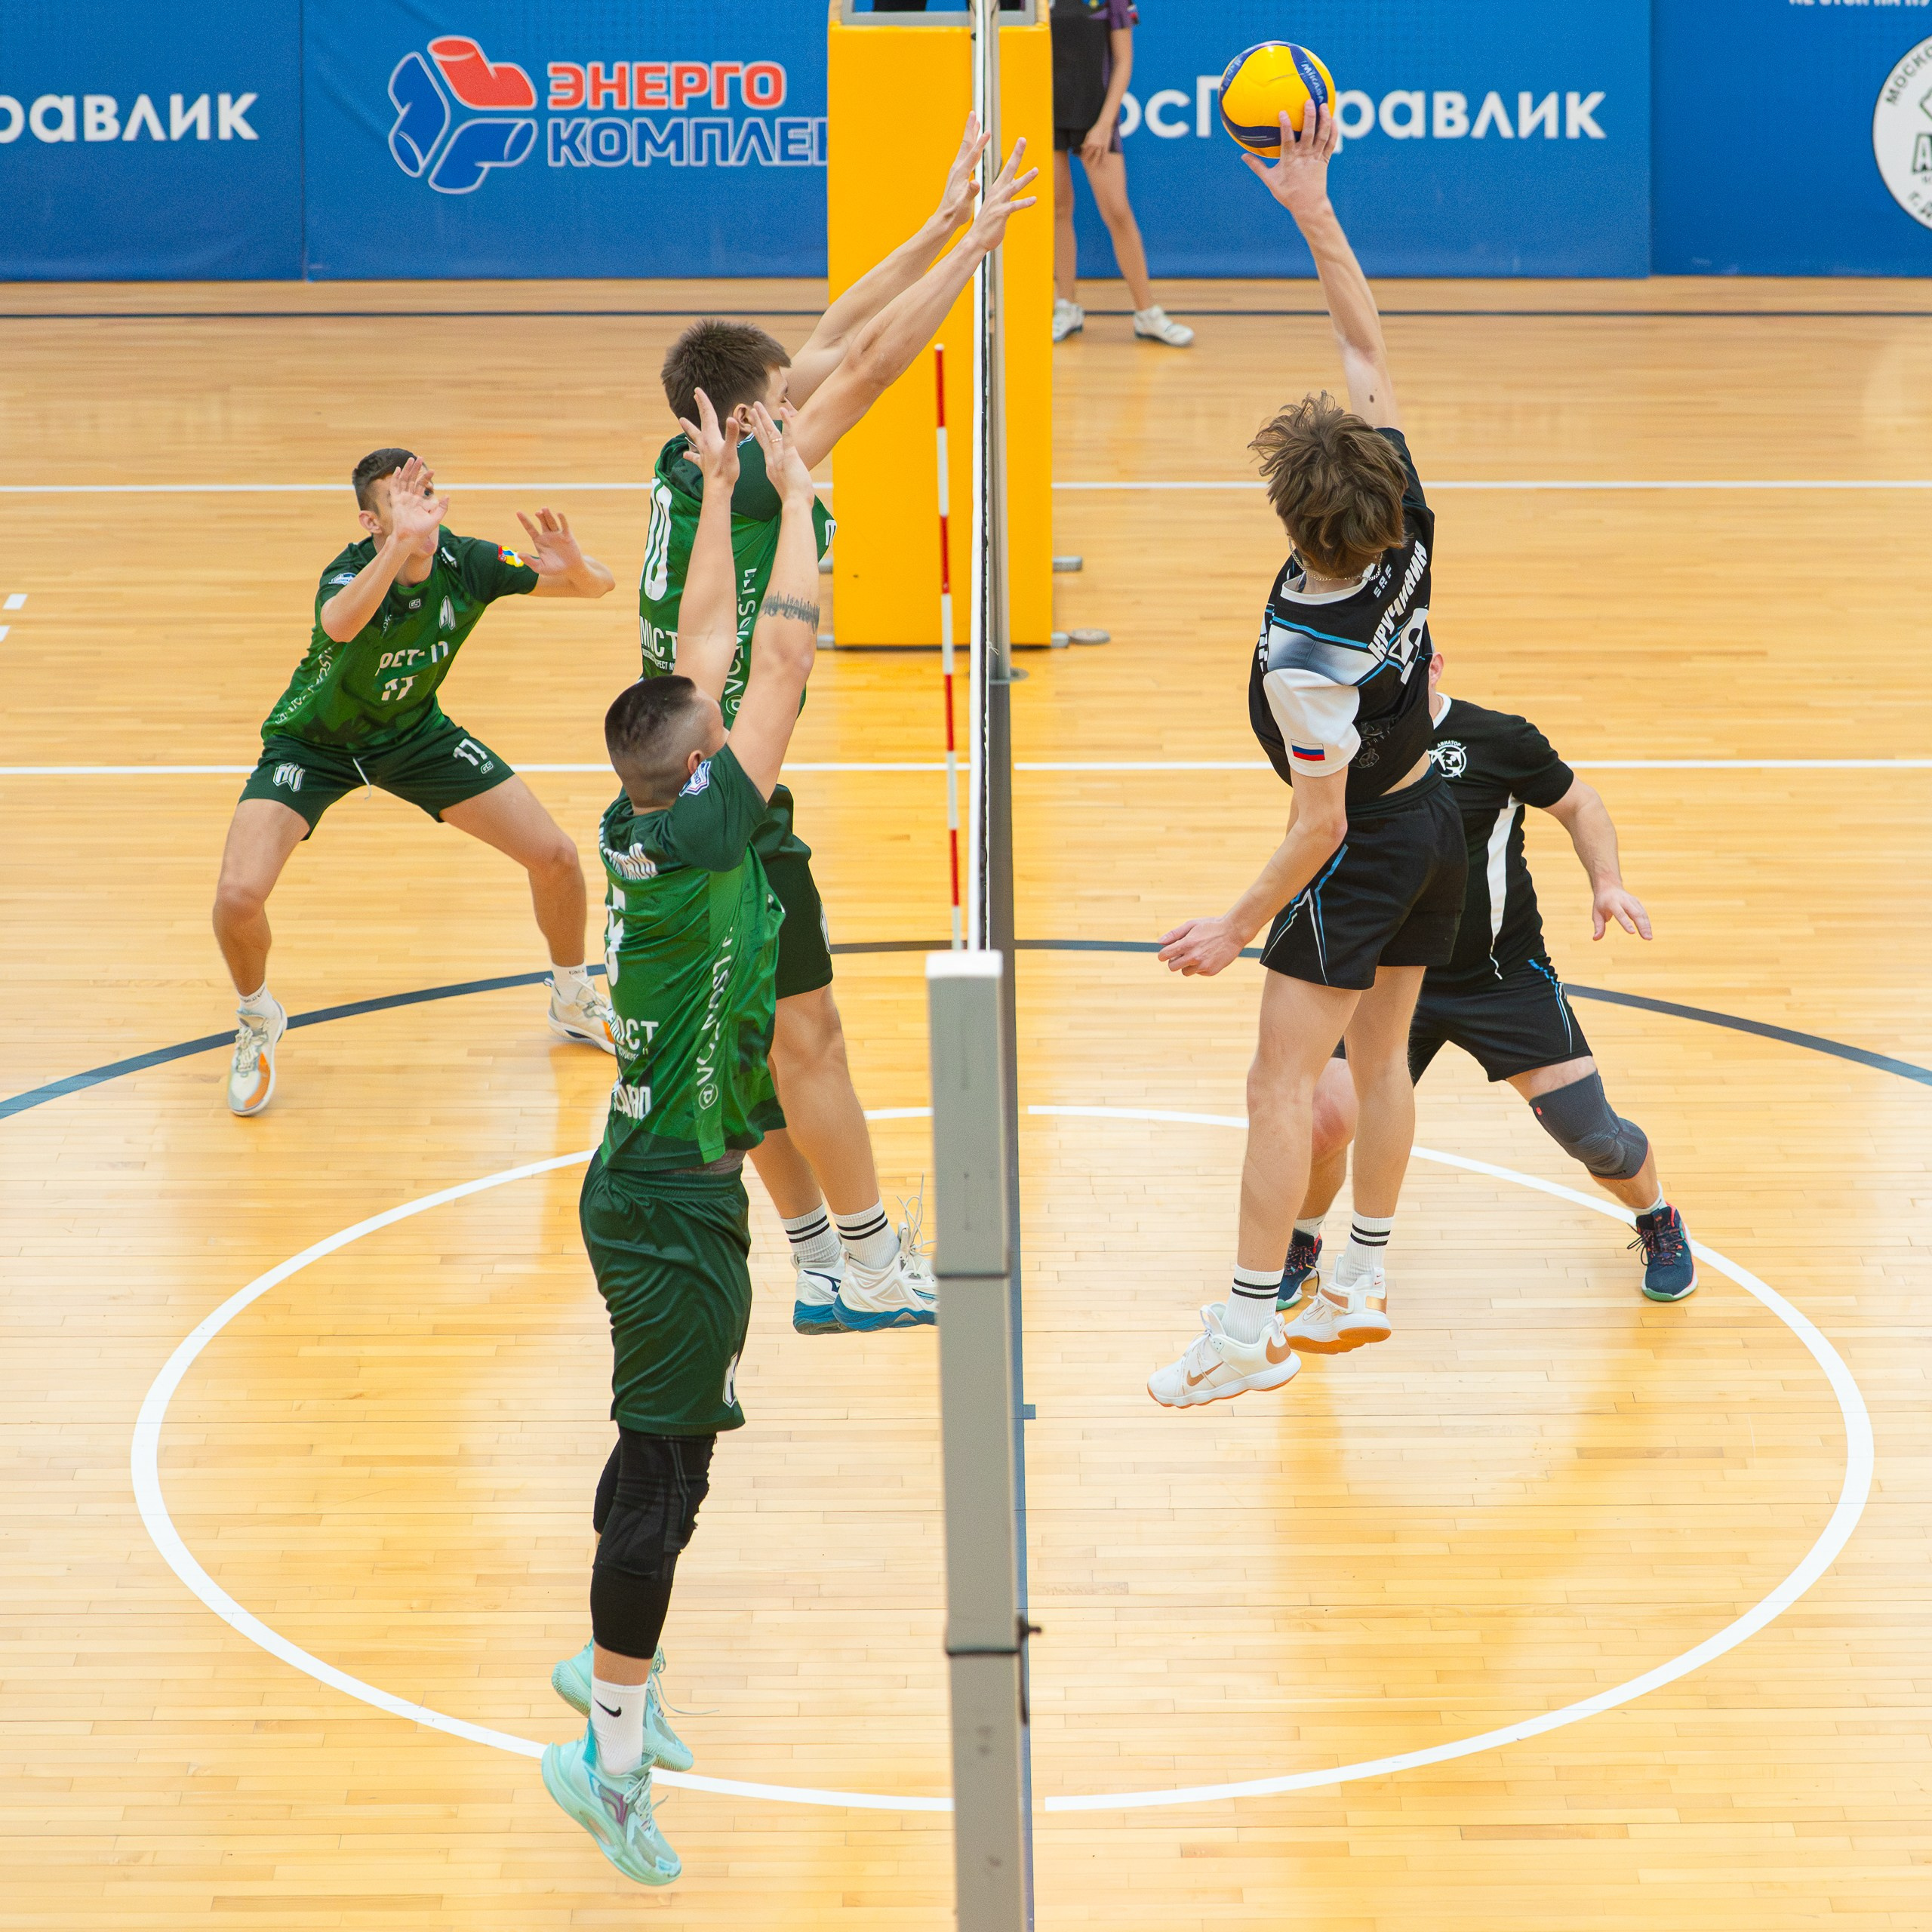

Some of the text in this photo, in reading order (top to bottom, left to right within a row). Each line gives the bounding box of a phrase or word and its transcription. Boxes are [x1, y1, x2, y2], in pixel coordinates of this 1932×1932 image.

[547, 60, 787, 110] ЭНЕРГО
[1367, 540, 1428, 662] КРУЧИНИН
[453, 738, 488, 766] 17
[1437, 740, 1462, 748] АВИАТОР
